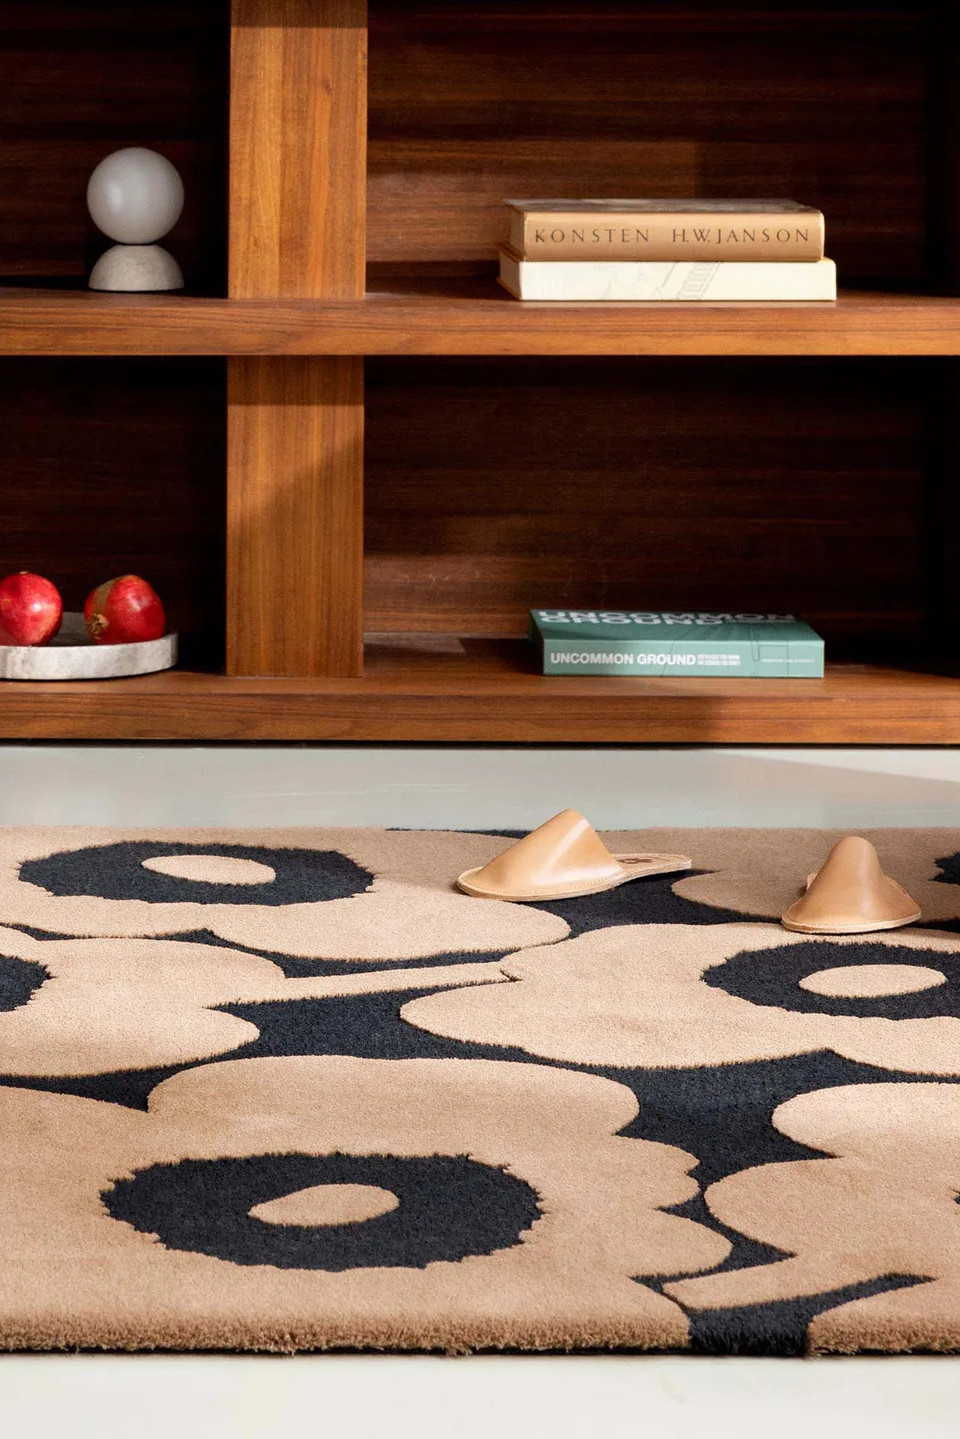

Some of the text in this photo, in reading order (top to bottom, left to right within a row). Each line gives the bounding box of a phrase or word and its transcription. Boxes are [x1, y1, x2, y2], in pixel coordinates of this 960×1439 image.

[534, 228, 650, 243] KONSTEN
[538, 610, 796, 620] UNCOMMON
[539, 616, 724, 626] GROUND
[550, 652, 634, 664] UNCOMMON
[636, 653, 697, 666] GROUND
